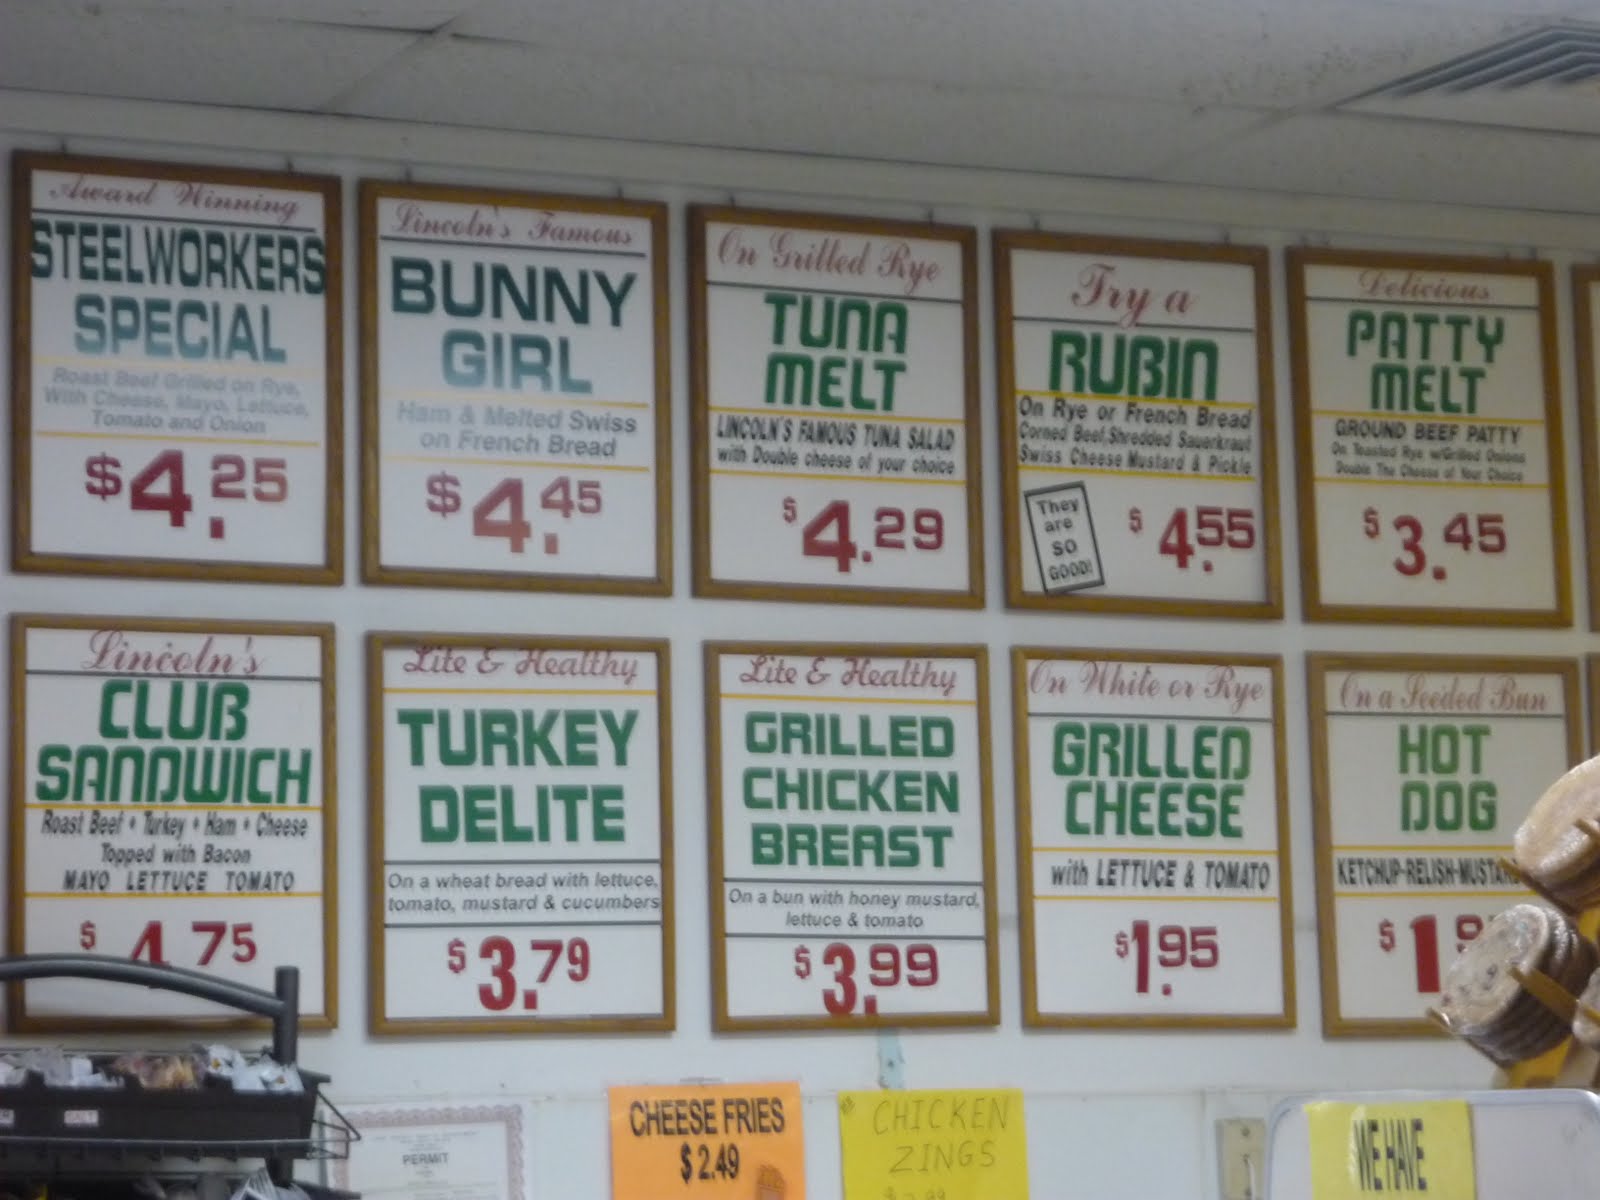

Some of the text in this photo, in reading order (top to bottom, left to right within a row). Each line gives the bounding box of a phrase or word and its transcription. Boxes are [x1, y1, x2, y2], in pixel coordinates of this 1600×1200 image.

[49, 173, 299, 223] Award Winning
[391, 201, 632, 244] Lincoln's Famous
[31, 218, 326, 295] STEELWORKERS
[717, 226, 942, 295] On Grilled Rye
[391, 255, 637, 327] BUNNY
[1071, 263, 1193, 329] Try a
[1357, 268, 1491, 300] Delicious
[74, 293, 287, 363] SPECIAL
[763, 292, 908, 354] TUNA
[1346, 309, 1505, 364] PATTY
[52, 367, 108, 385] Roast
[115, 370, 157, 387] Beef
[164, 373, 226, 392] Grilled
[231, 379, 255, 394] on
[442, 328, 592, 394] GIRL
[1048, 329, 1219, 403] RUBIN
[44, 387, 87, 405] With
[764, 352, 907, 411] MELT
[1370, 363, 1486, 415] MELT
[91, 409, 266, 434] Tomato and Onion
[397, 401, 637, 433] Ham & Melted Swiss
[1019, 396, 1252, 429] On Rye or French Bread
[1019, 421, 1068, 441] Corned
[1335, 419, 1522, 445] GROUND BEEF PATTY
[420, 429, 616, 457] on French Bread
[716, 414, 956, 451] LINCOLN'S FAMOUS TUNA SALAD
[717, 445, 955, 475] with Double cheese of your choice
[1019, 444, 1062, 464] Swiss
[1070, 447, 1122, 468] Cheese
[1127, 450, 1185, 471] Mustard
[1191, 454, 1200, 472] &
[1036, 498, 1079, 516] They
[1044, 517, 1073, 533] are
[81, 629, 265, 675] Lincoln's
[403, 646, 639, 685] Lite & Healthy
[739, 655, 957, 696] Lite & Healthy
[1029, 659, 1265, 714] On White or Rye
[1339, 673, 1548, 711] On a Seeded Bun
[99, 678, 251, 741] CLUB
[397, 708, 639, 767] TURKEY
[745, 710, 955, 759] GRILLED
[1052, 721, 1252, 780] GRILLED
[1398, 724, 1491, 775] HOT
[36, 743, 312, 804] SANDWICH
[743, 766, 960, 813] CHICKEN
[41, 810, 309, 840] Roast Beef Turkey Ham Cheese
[419, 784, 626, 844] DELITE
[1065, 779, 1245, 838] CHEESE
[1401, 780, 1497, 832] DOG
[100, 843, 251, 867] Topped with Bacon
[751, 822, 953, 868] BREAST
[63, 869, 296, 892] MAYO LETTUCE TOMATO
[387, 872, 659, 890] On a wheat bread with lettuce,
[1051, 858, 1271, 891] with LETTUCE & TOMATO
[387, 894, 661, 914] tomato, mustard & cucumbers
[728, 888, 981, 910] On a bun with honey mustard,
[785, 911, 924, 929] lettuce & tomato
[630, 1097, 785, 1136] CHEESE FRIES
[873, 1096, 1009, 1135] CHICKEN
[402, 1152, 449, 1165] PERMIT
[889, 1140, 995, 1173] ZINGS
